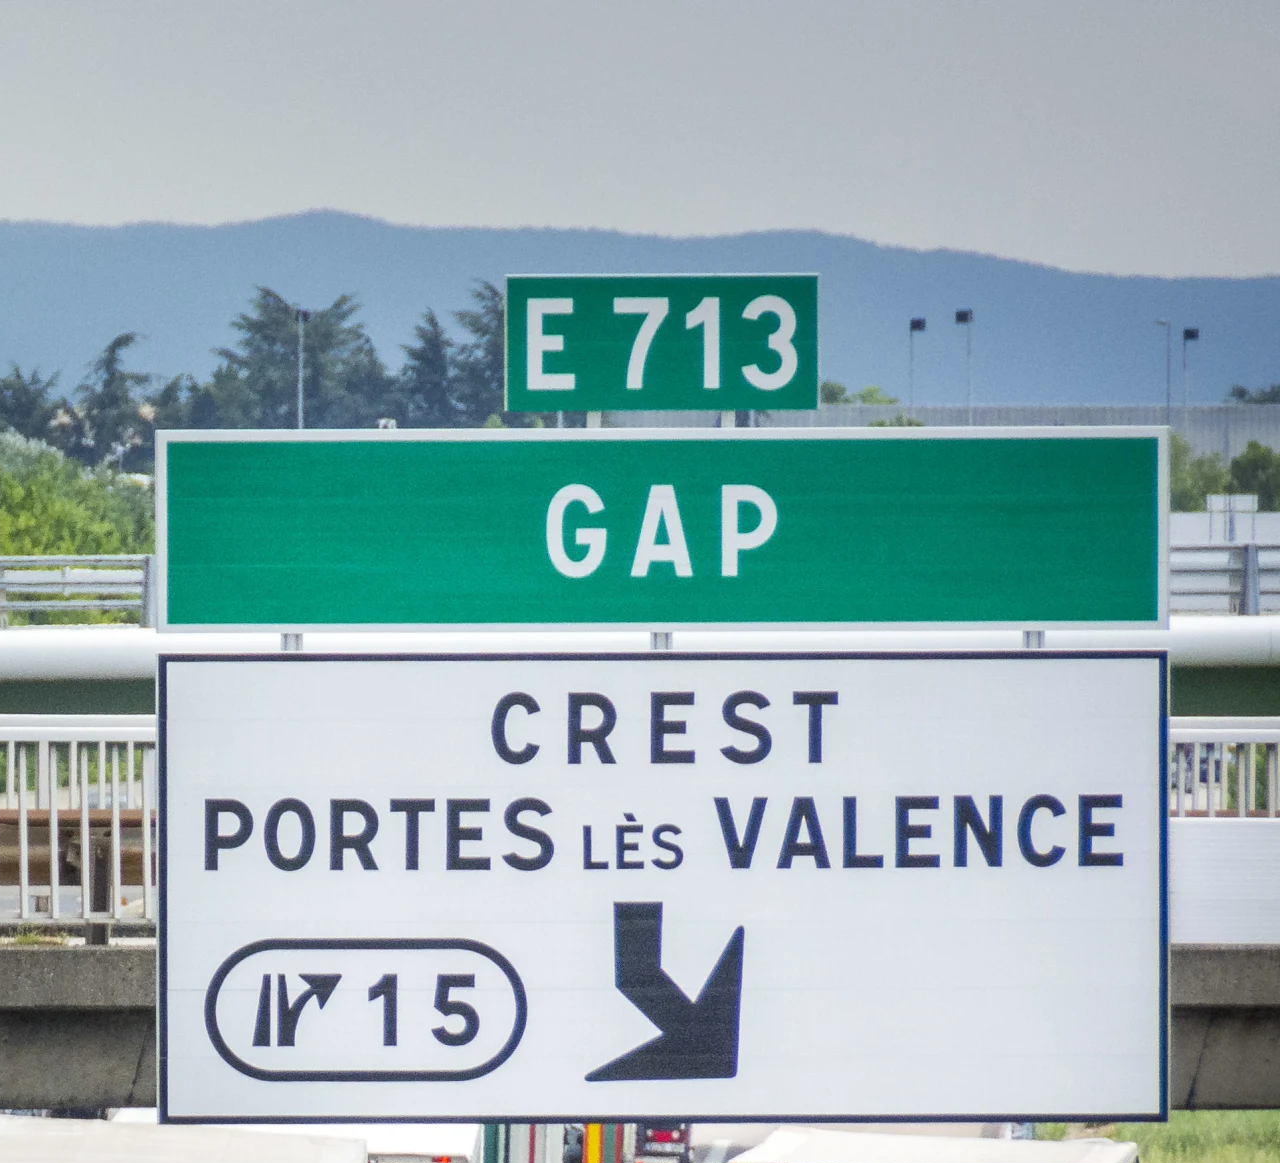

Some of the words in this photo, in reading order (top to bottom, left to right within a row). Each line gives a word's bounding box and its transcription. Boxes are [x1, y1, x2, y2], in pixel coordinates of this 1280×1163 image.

[525, 298, 576, 391] E
[613, 294, 798, 391] 713
[545, 483, 779, 579] GAP
[490, 690, 840, 766] CREST
[203, 796, 555, 872] PORTES
[582, 814, 684, 871] LÈS
[713, 793, 1125, 870] VALENCE
[366, 973, 482, 1048] 15
